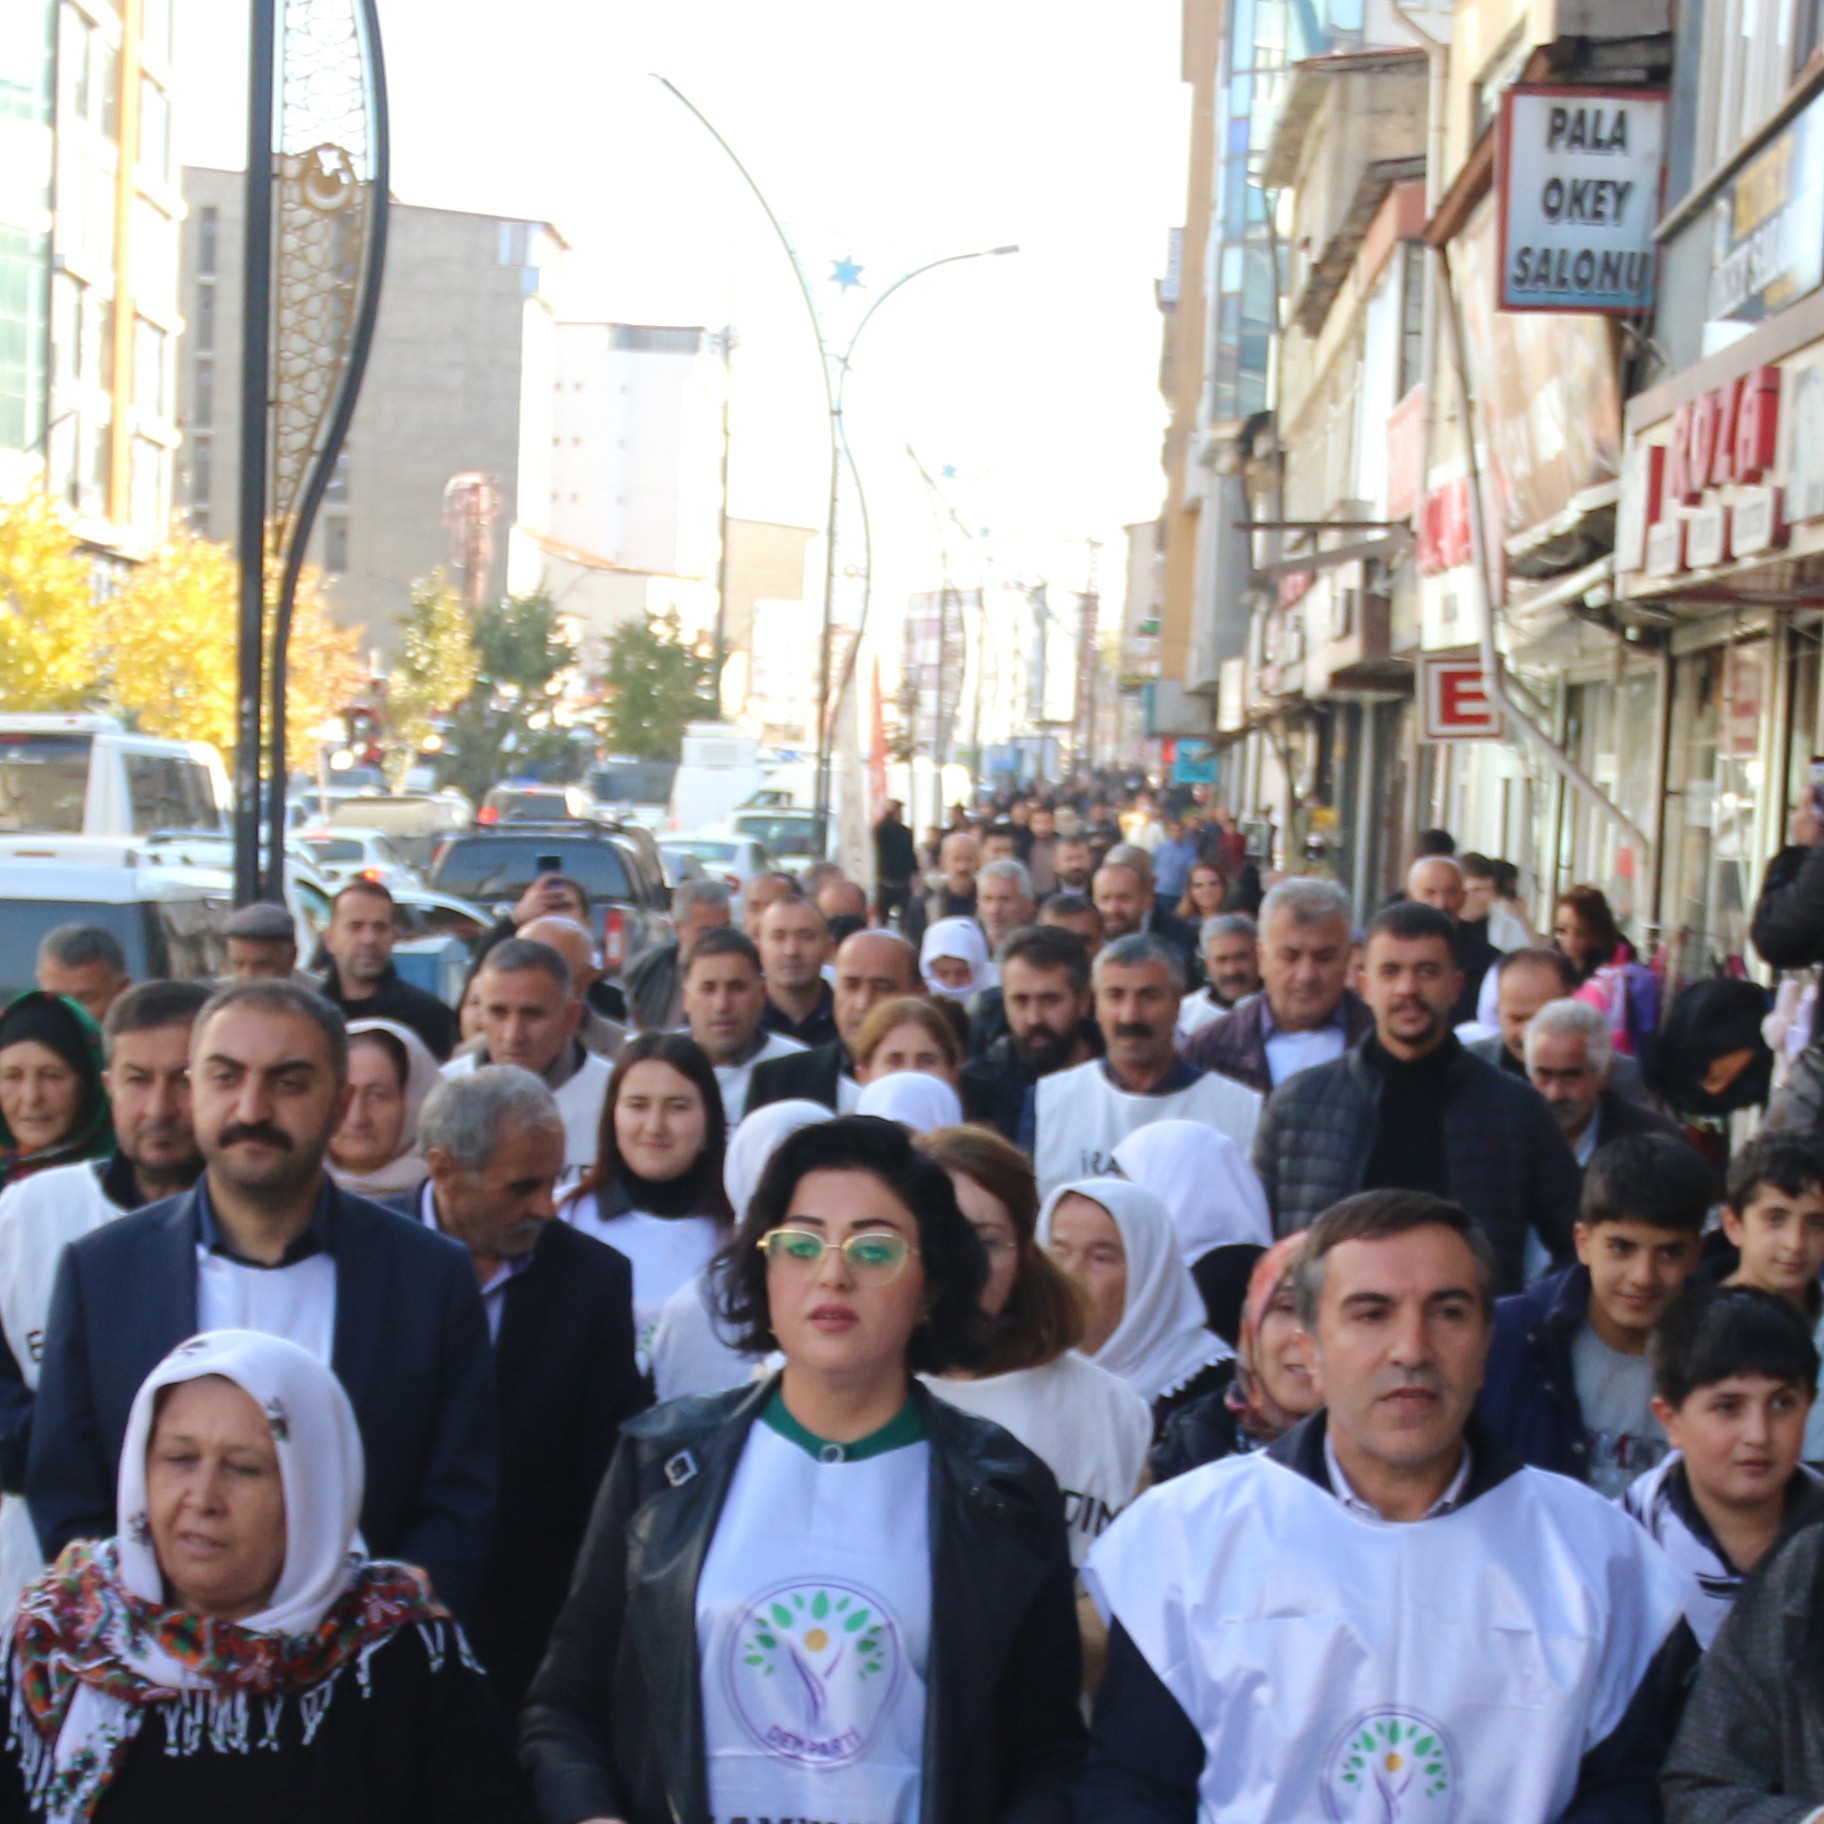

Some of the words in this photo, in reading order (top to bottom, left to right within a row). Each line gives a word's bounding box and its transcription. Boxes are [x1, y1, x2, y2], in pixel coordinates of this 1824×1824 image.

[1547, 107, 1628, 152] PALA
[1542, 177, 1633, 222] OKEY
[1512, 246, 1651, 293] SALONU
[1440, 671, 1492, 726] E
